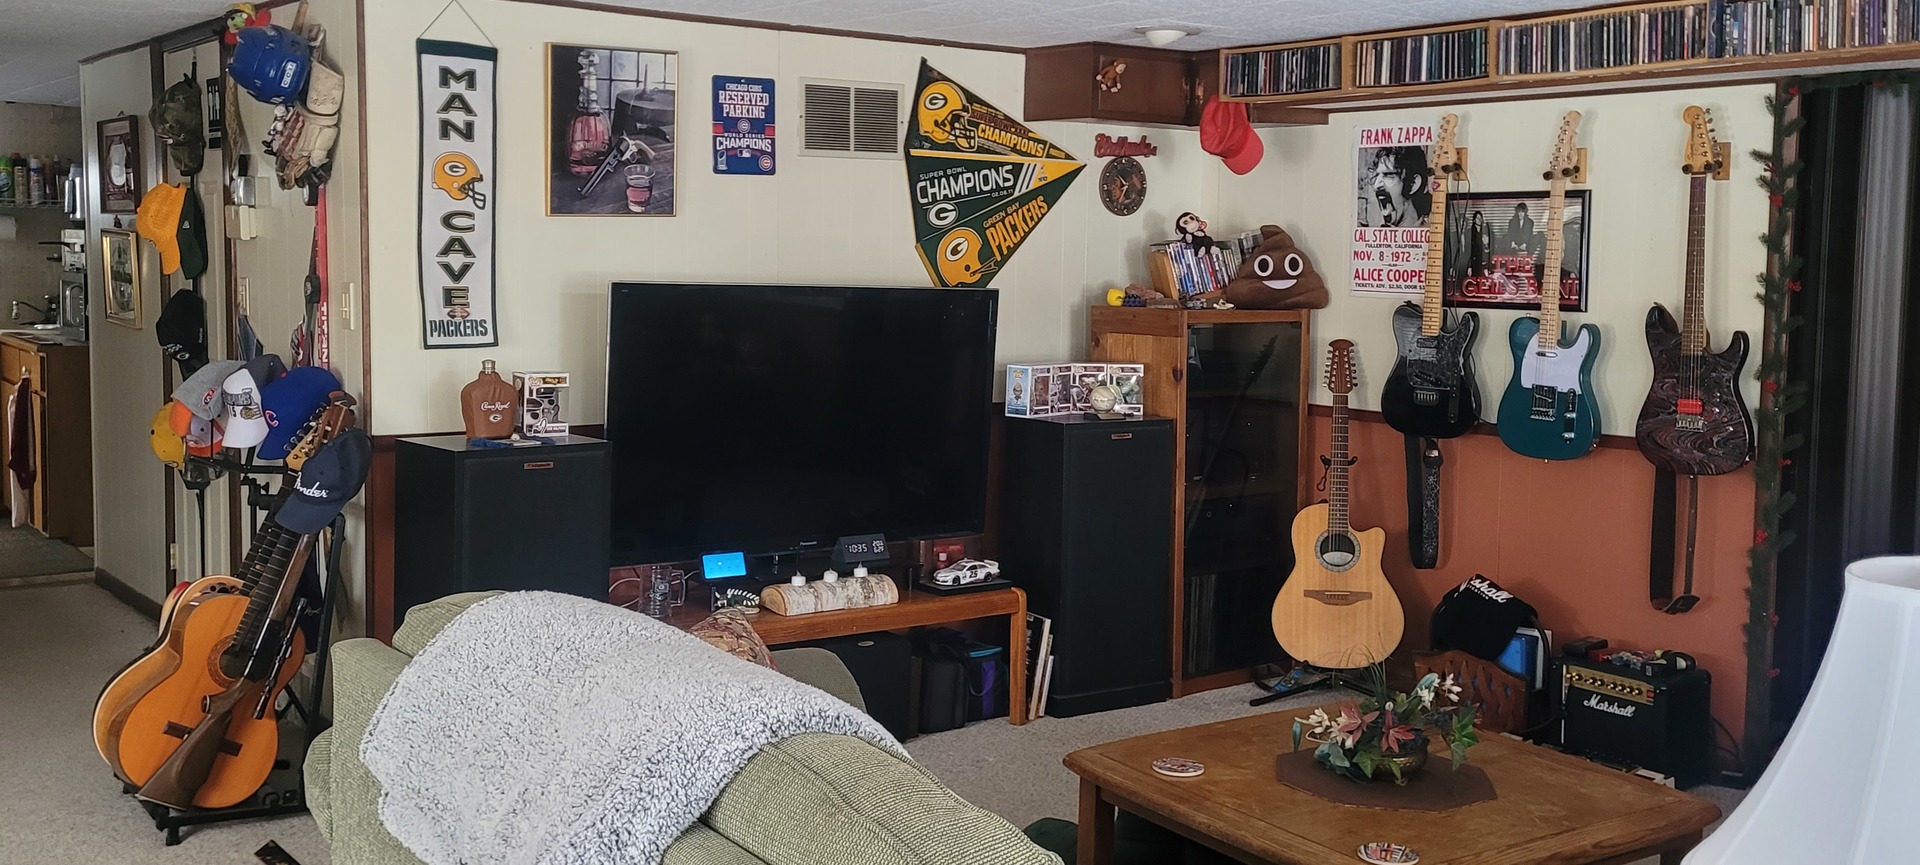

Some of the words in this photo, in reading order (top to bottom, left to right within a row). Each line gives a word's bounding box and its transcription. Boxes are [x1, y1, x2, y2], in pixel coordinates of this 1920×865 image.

[725, 83, 748, 92] CHICAGO
[748, 84, 762, 92] CUBS
[436, 65, 478, 143] MAN
[718, 90, 769, 106] RESERVED
[723, 104, 765, 118] PARKING
[716, 136, 772, 152] CHAMPIONS
[977, 123, 1044, 157] CHAMPIONS
[1360, 128, 1394, 145] FRANK
[1397, 126, 1433, 144] ZAPPA
[920, 170, 944, 180] SUPER
[946, 166, 968, 174] BOWL
[916, 164, 1014, 204] CHAMPIONS
[983, 210, 1006, 228] GREEN
[1006, 202, 1020, 214] BAY
[985, 195, 1048, 262] PACKERS
[1354, 229, 1370, 242] CAL.
[1372, 229, 1398, 243] STATE
[1402, 230, 1430, 244] COLLEG
[435, 210, 477, 309] CAVE
[1353, 250, 1374, 261] NOV.
[1354, 268, 1384, 282] ALICE
[1491, 255, 1534, 276] THE
[428, 318, 488, 338] PACKERS
[293, 471, 328, 498] nder
[968, 570, 978, 578] 25
[1583, 694, 1636, 718] Marshall
